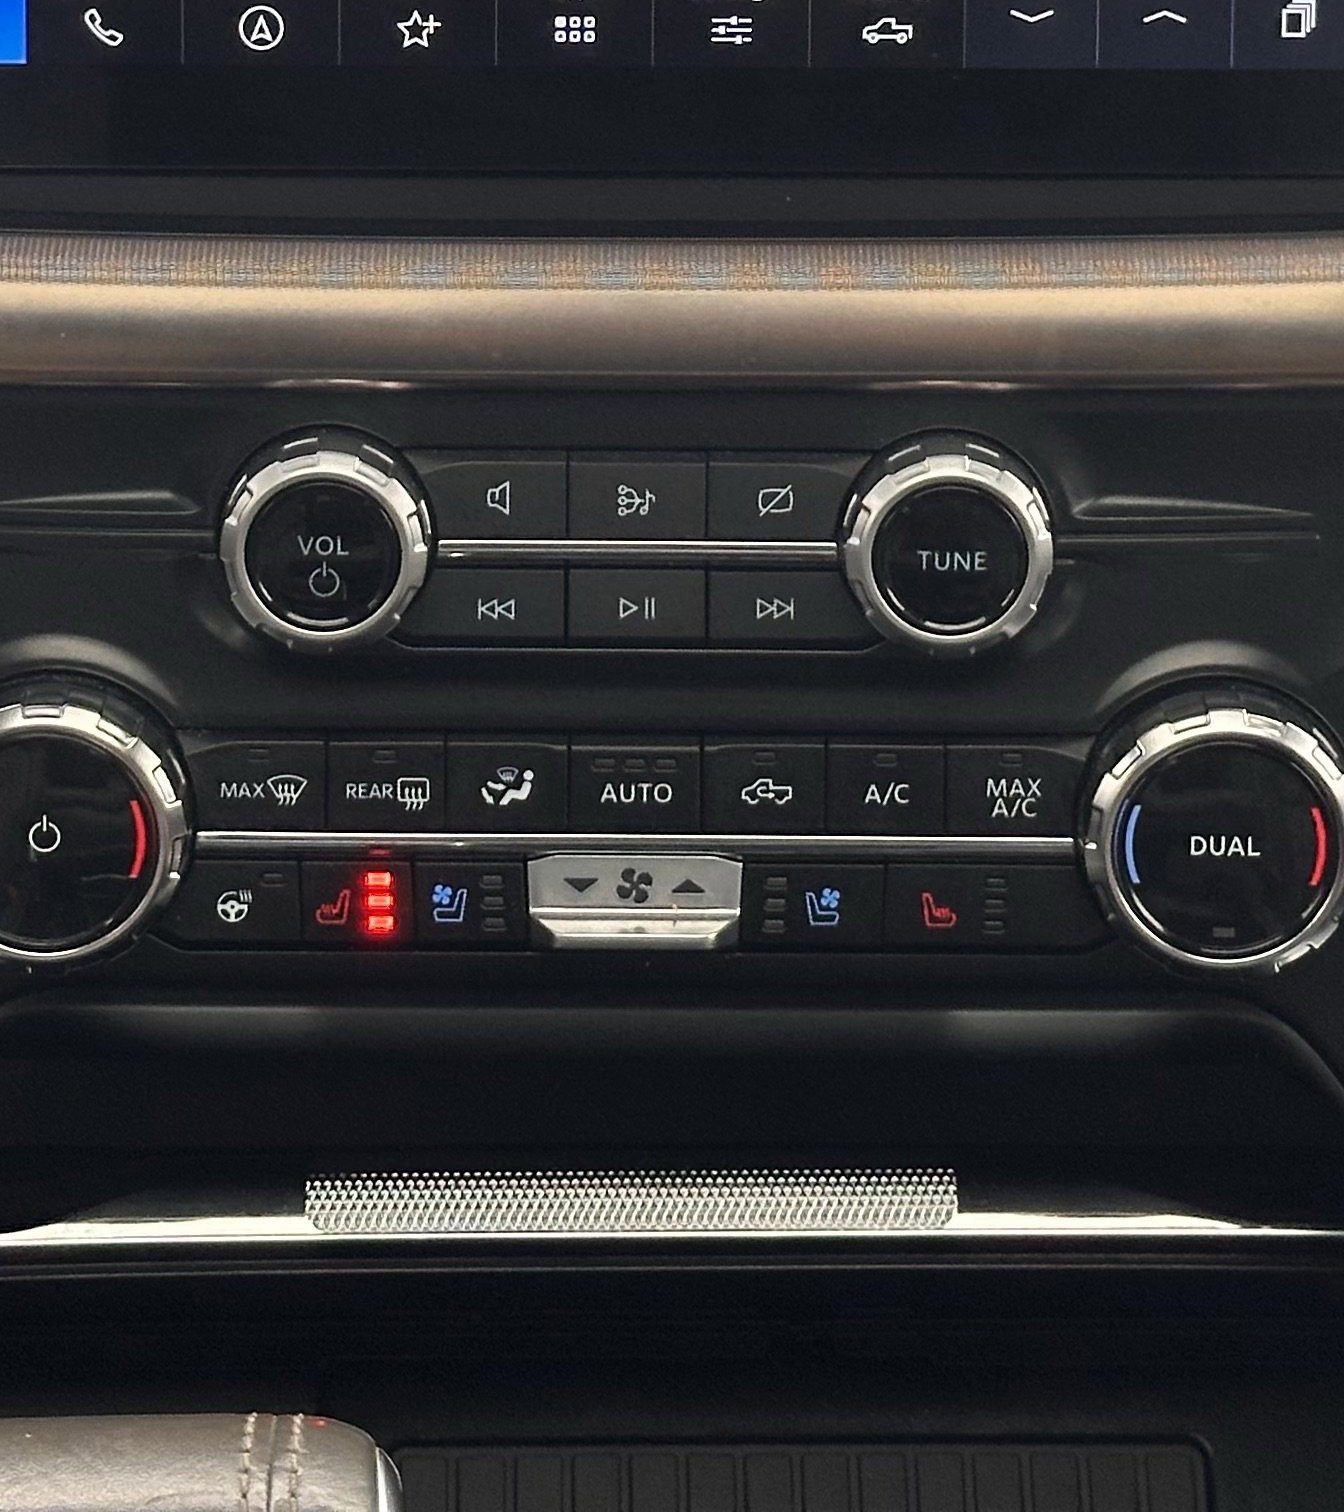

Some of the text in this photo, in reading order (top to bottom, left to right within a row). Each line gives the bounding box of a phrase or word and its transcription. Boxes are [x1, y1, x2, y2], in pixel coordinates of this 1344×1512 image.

[297, 535, 350, 556] VOL
[917, 550, 987, 571] TUNE
[220, 782, 265, 798] MAX
[346, 783, 394, 799] REAR
[600, 783, 673, 803] AUTO
[864, 782, 909, 806] A/C
[986, 778, 1042, 798] MAX
[991, 797, 1037, 818] A/C
[1190, 835, 1261, 857] DUAL
